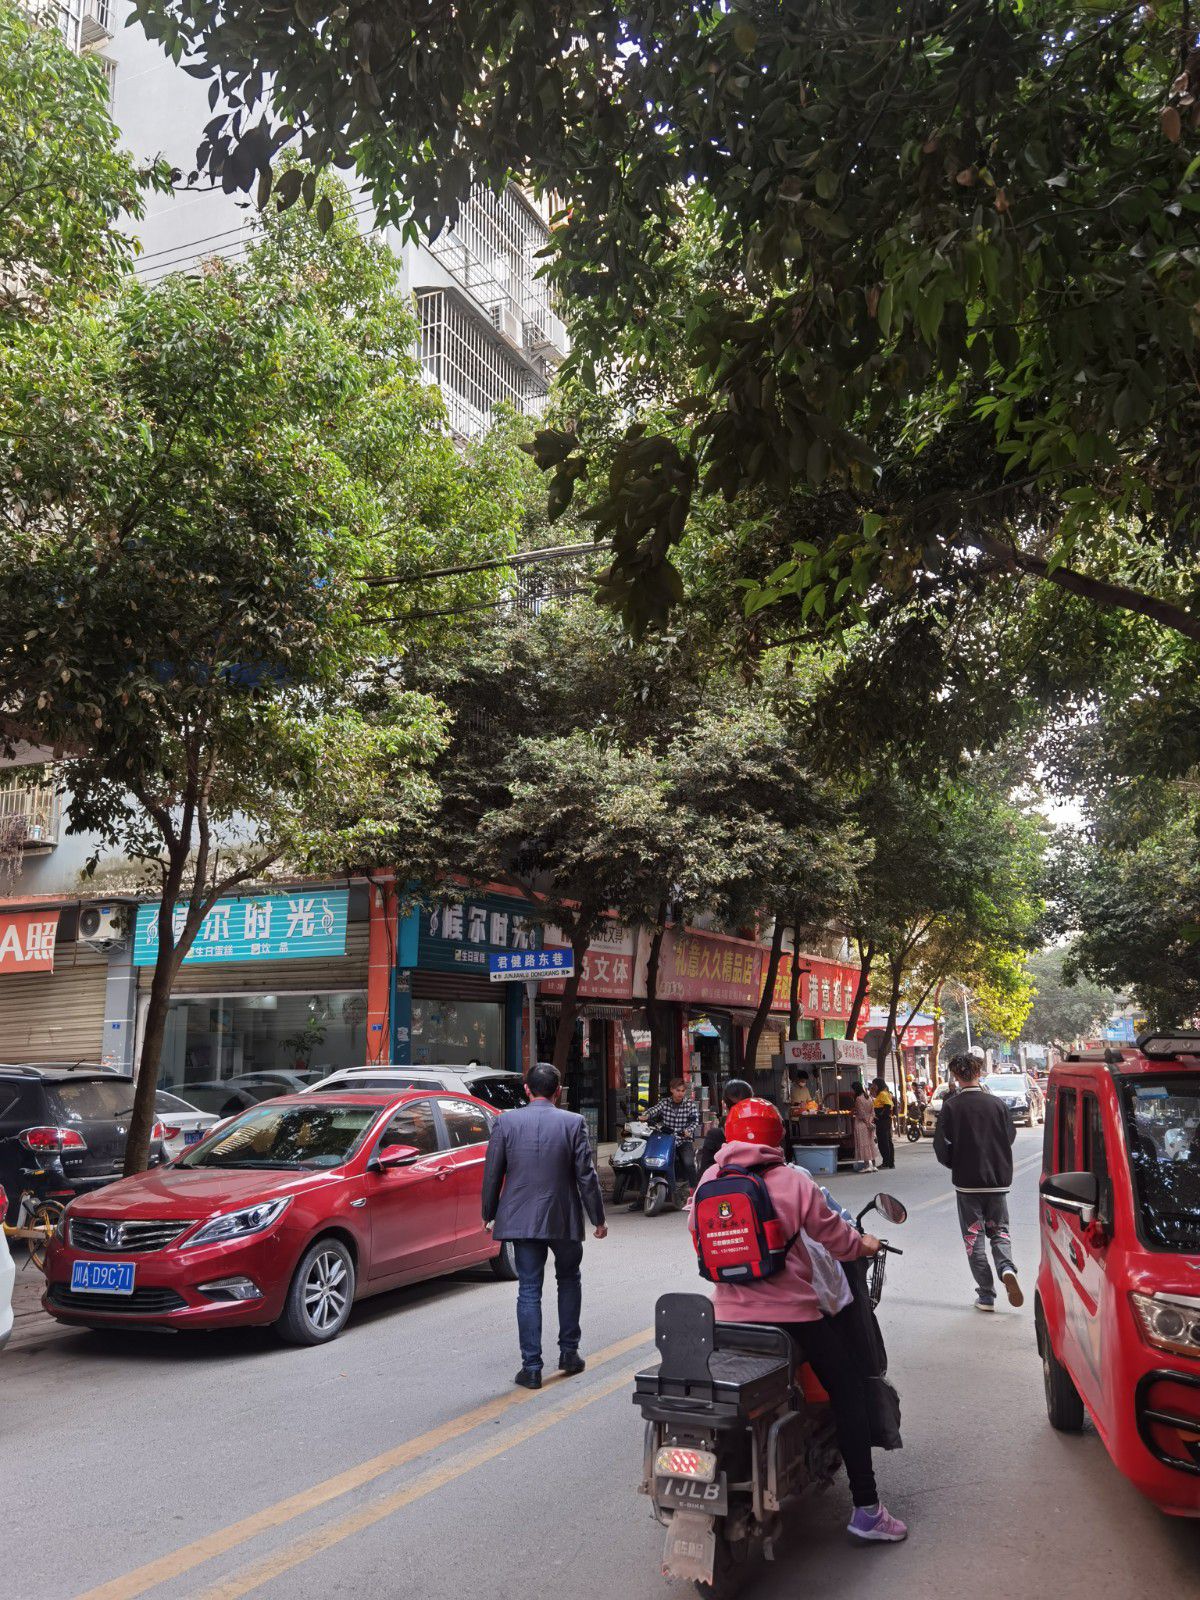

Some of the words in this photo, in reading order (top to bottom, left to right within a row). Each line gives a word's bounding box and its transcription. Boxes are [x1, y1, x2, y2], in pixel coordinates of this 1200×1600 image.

[196, 944, 233, 957] 生日蛋糕
[497, 952, 563, 969] 君健路东巷
